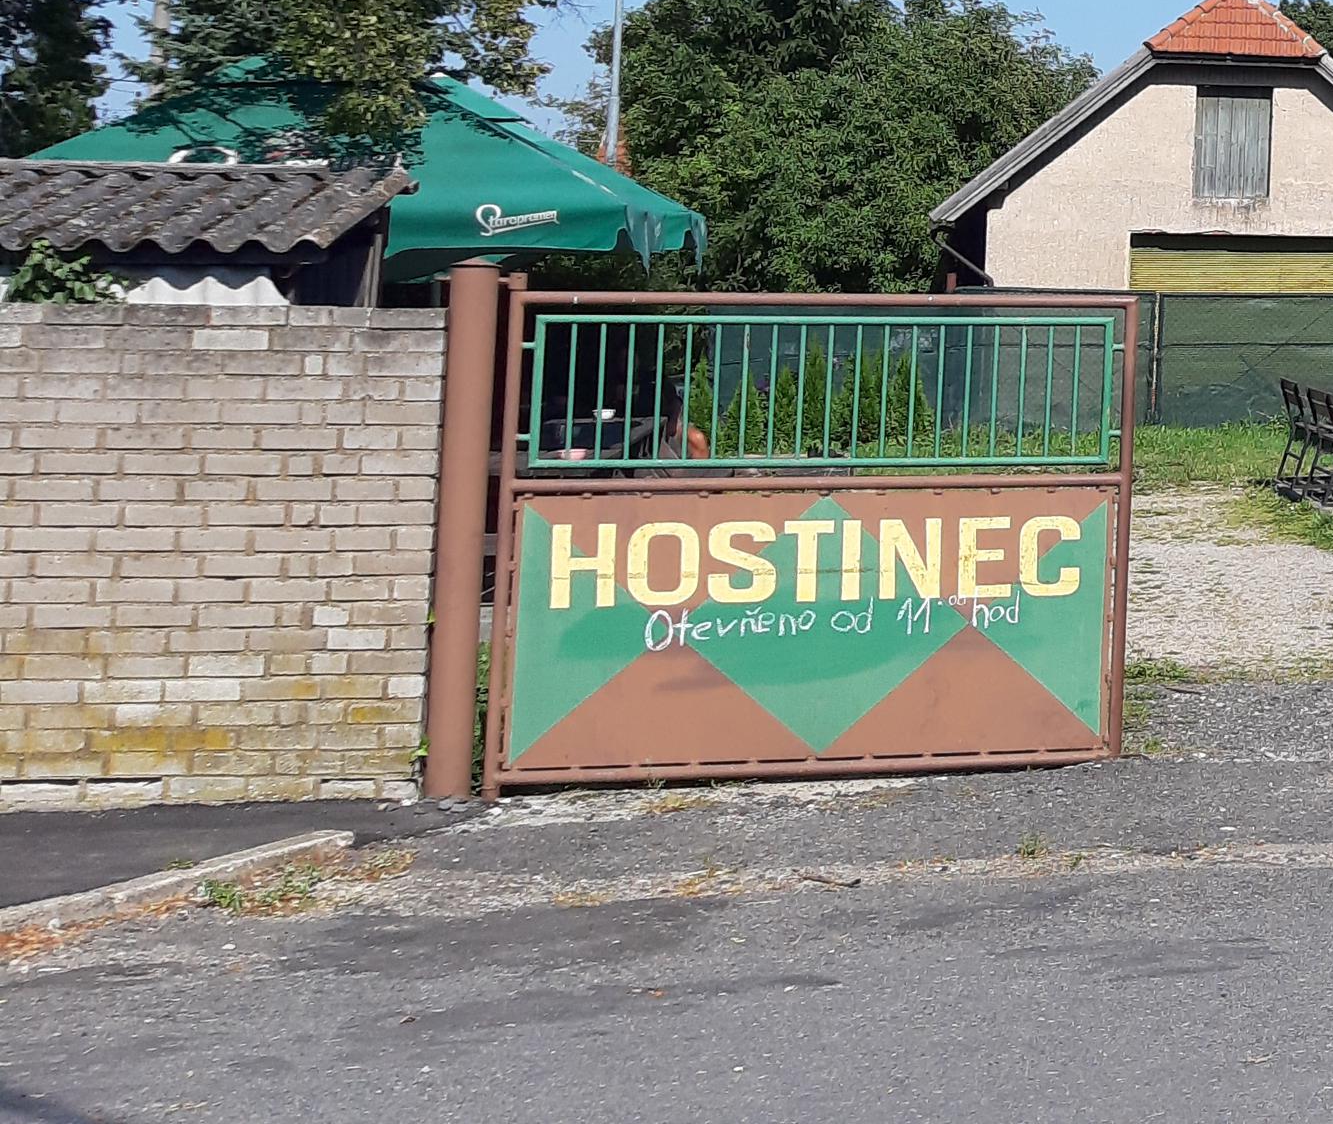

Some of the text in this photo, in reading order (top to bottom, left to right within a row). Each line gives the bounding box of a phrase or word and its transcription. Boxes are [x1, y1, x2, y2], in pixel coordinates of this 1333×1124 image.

[475, 203, 560, 237] Staropramen
[549, 515, 1082, 610] HOSTINEC
[830, 596, 875, 634] od
[971, 588, 1021, 629] hod
